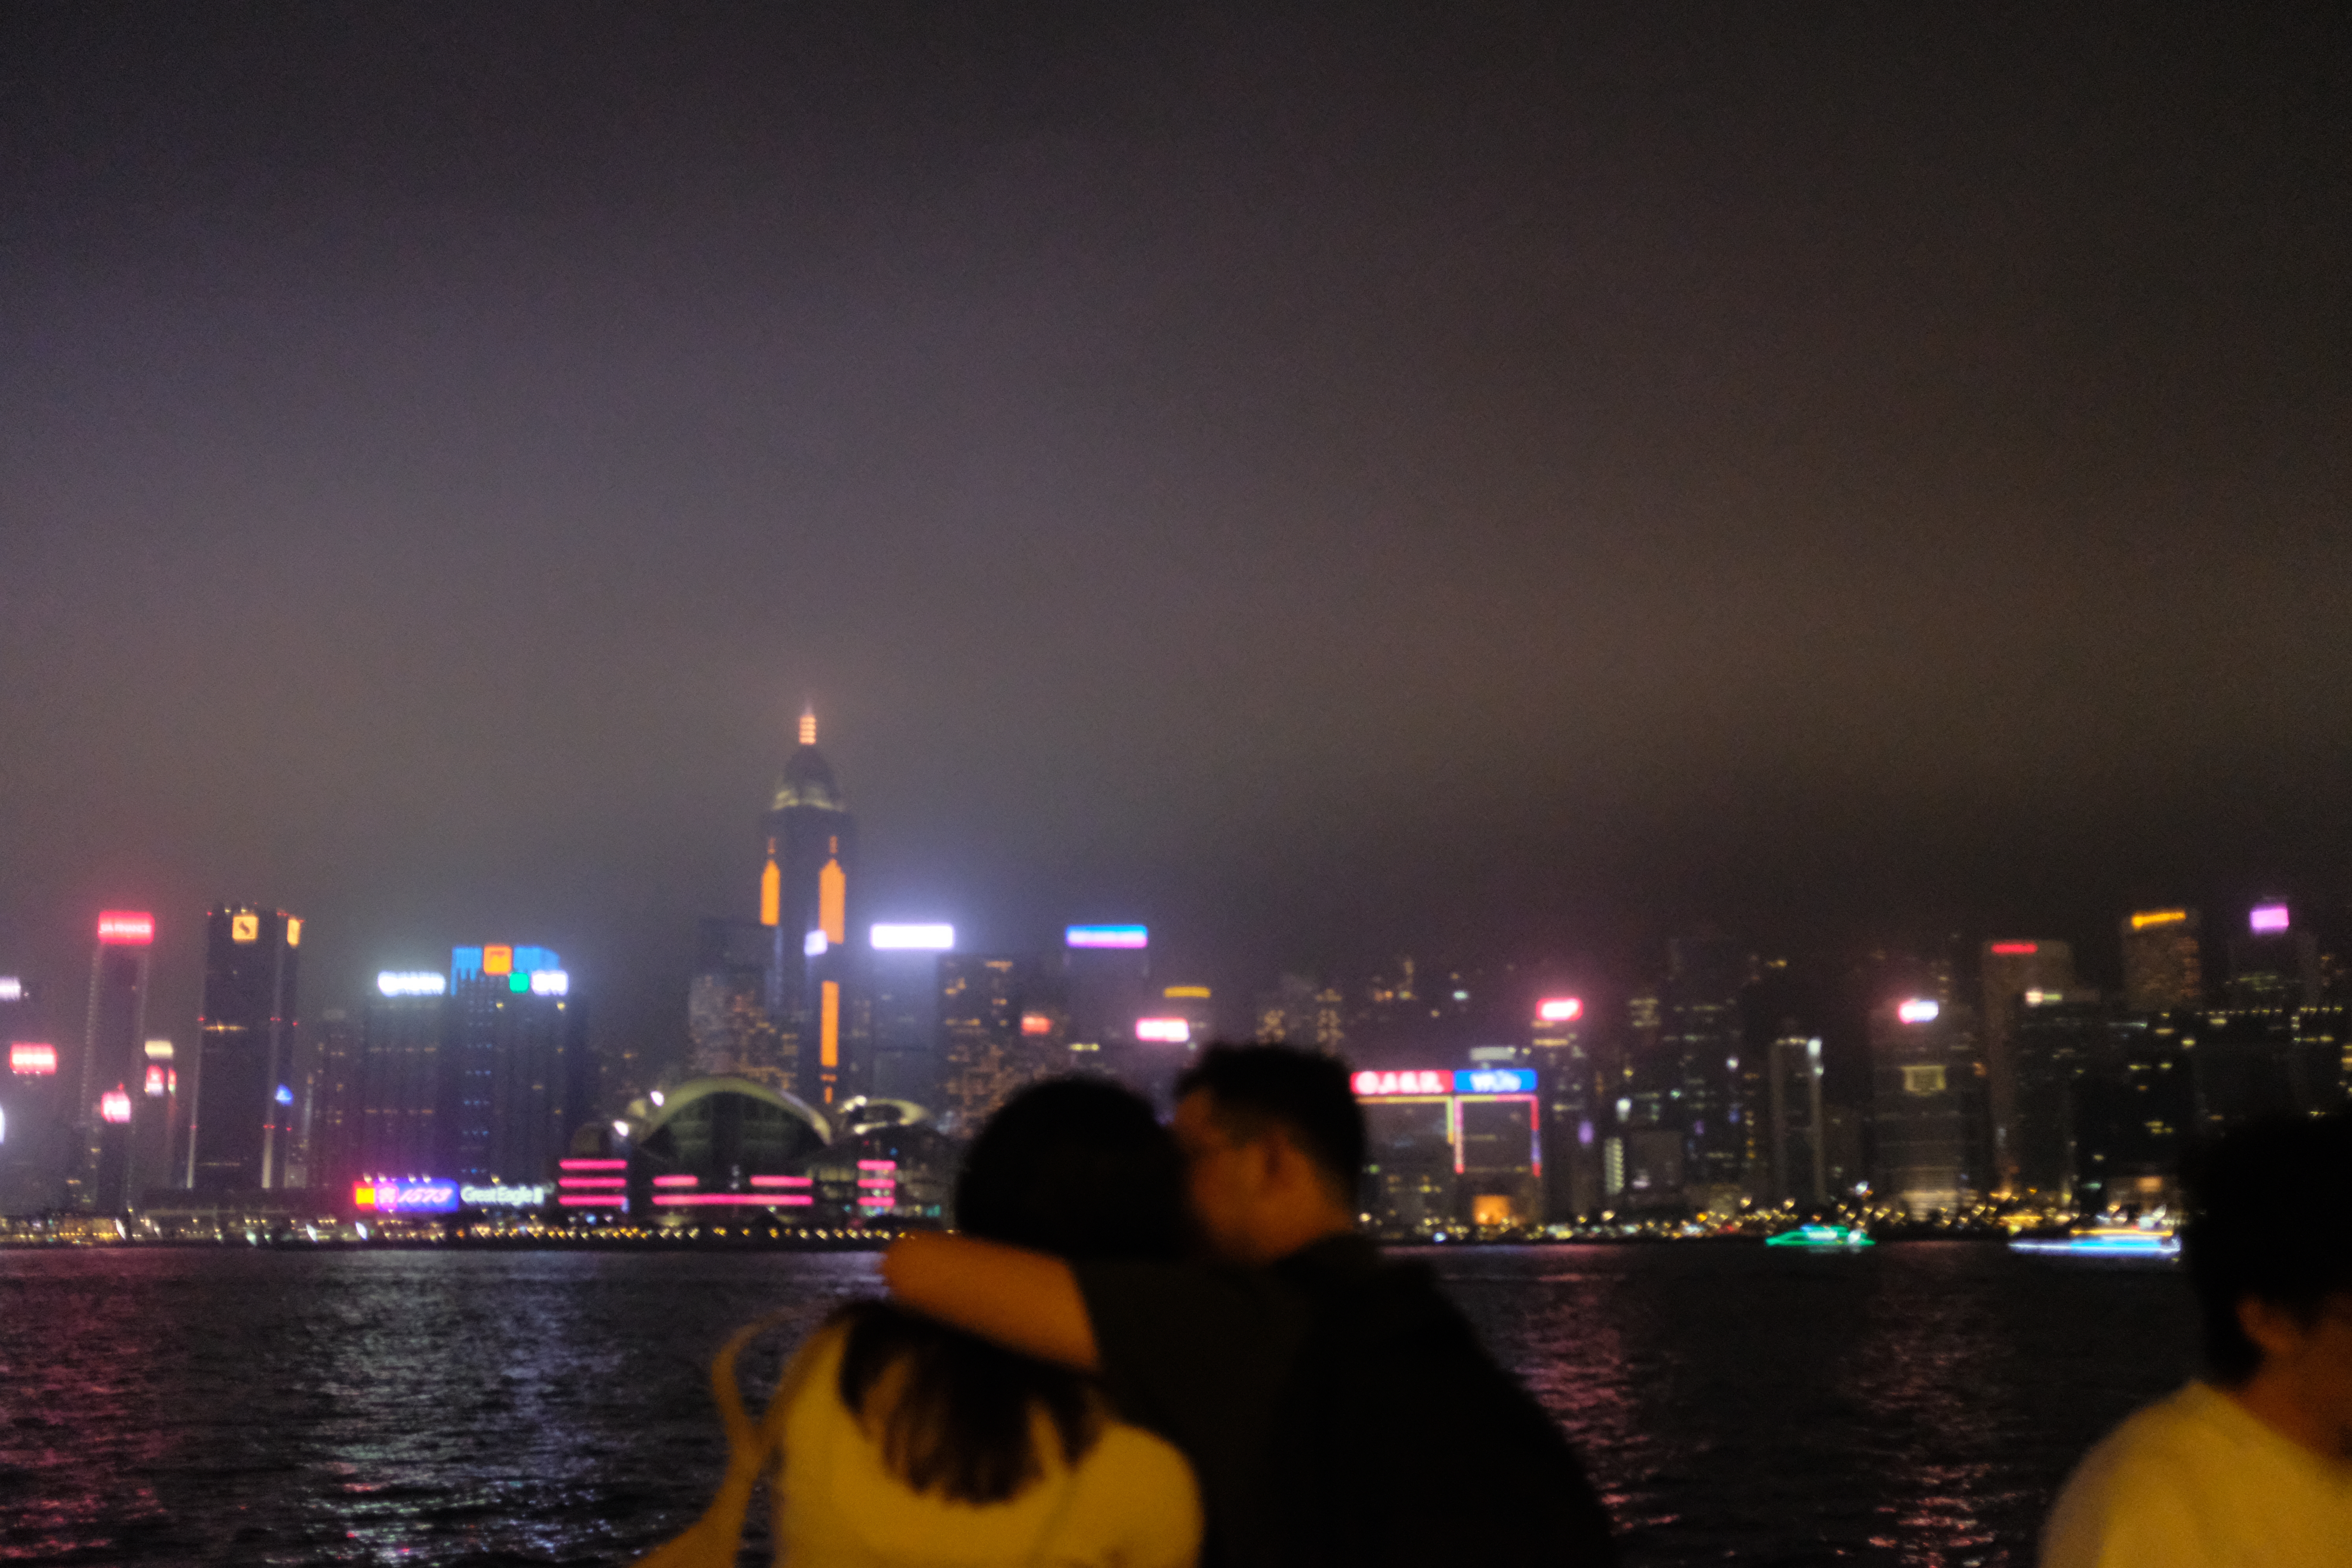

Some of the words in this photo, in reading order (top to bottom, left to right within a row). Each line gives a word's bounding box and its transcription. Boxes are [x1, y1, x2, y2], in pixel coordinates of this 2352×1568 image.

[115, 924, 151, 932] FINANCE
[397, 1188, 453, 1203] 1573
[461, 1186, 496, 1202] Great
[497, 1185, 532, 1206] Eagle
